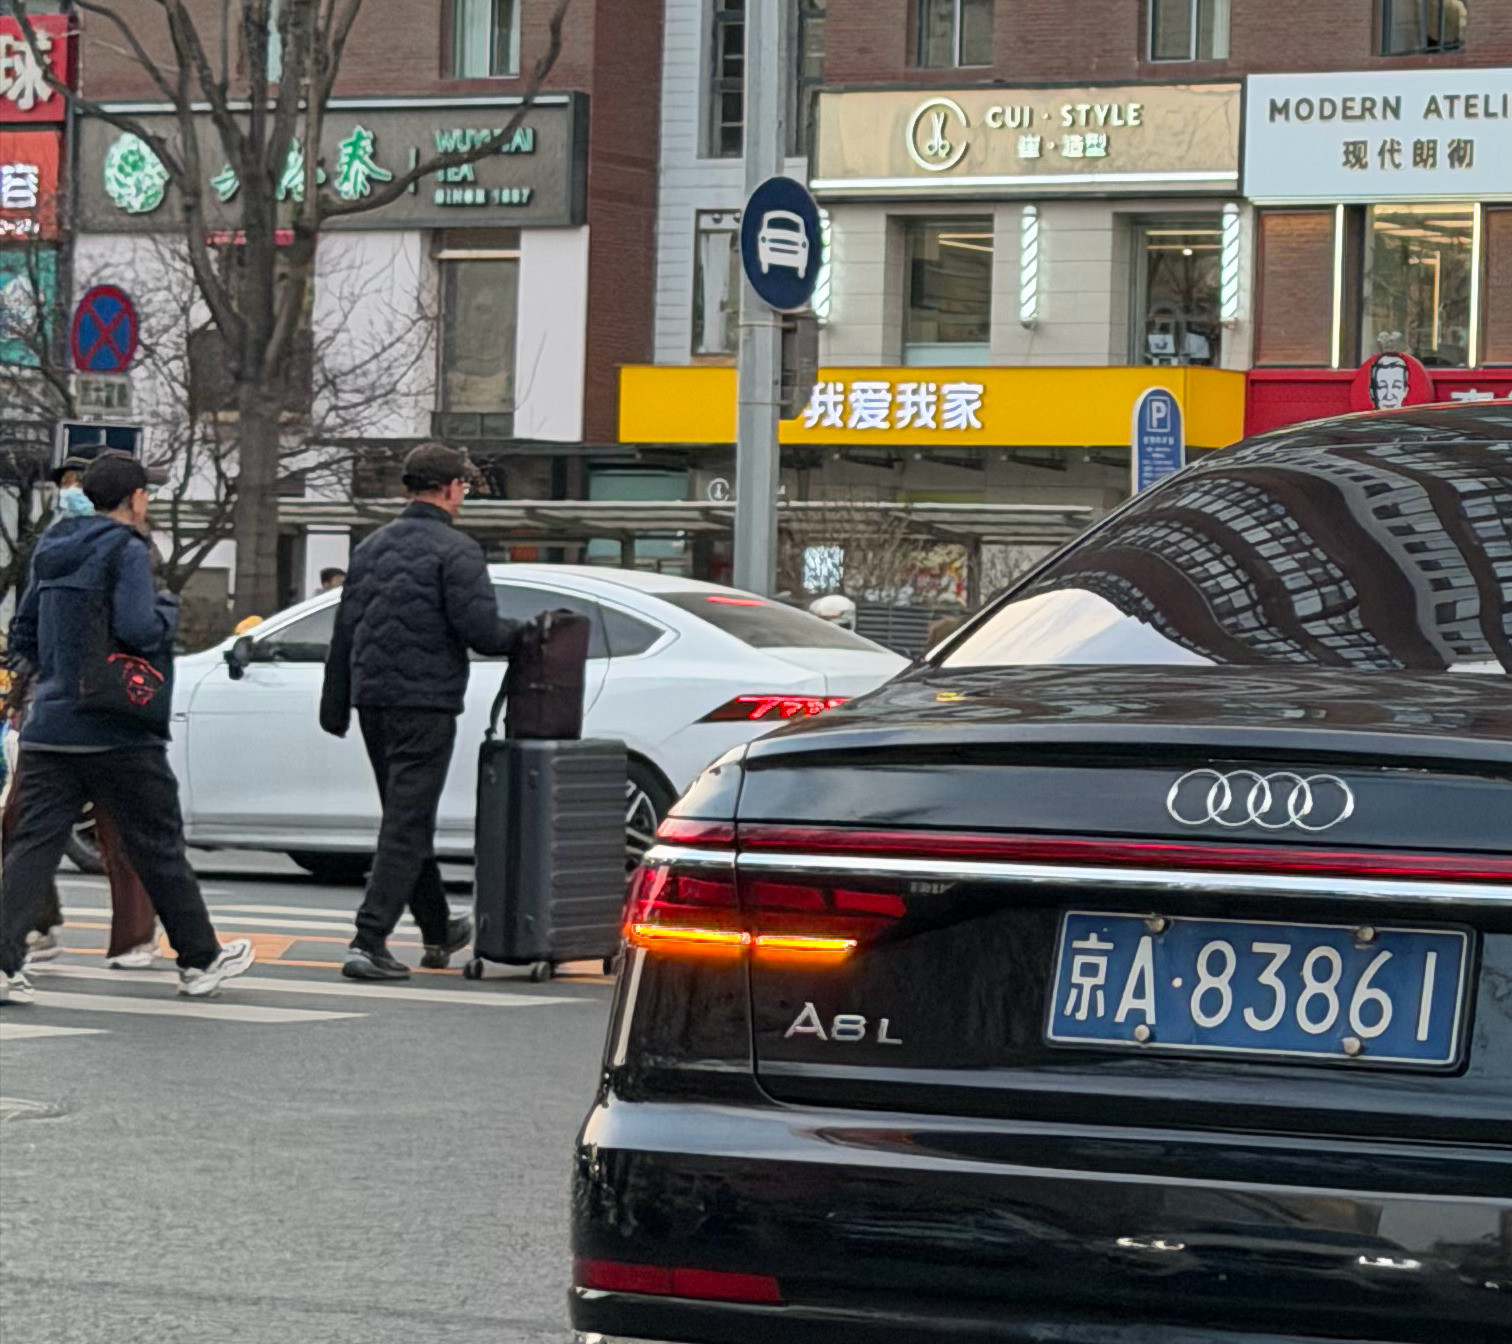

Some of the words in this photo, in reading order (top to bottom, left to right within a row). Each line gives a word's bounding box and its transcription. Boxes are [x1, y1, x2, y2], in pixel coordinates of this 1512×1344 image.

[986, 105, 1031, 129] CUI
[1060, 102, 1144, 127] STYLE
[1268, 95, 1403, 123] MODERN
[1342, 138, 1476, 172] 现代朗彻
[804, 380, 985, 432] 我爱我家
[1063, 933, 1438, 1042] 京A·83861
